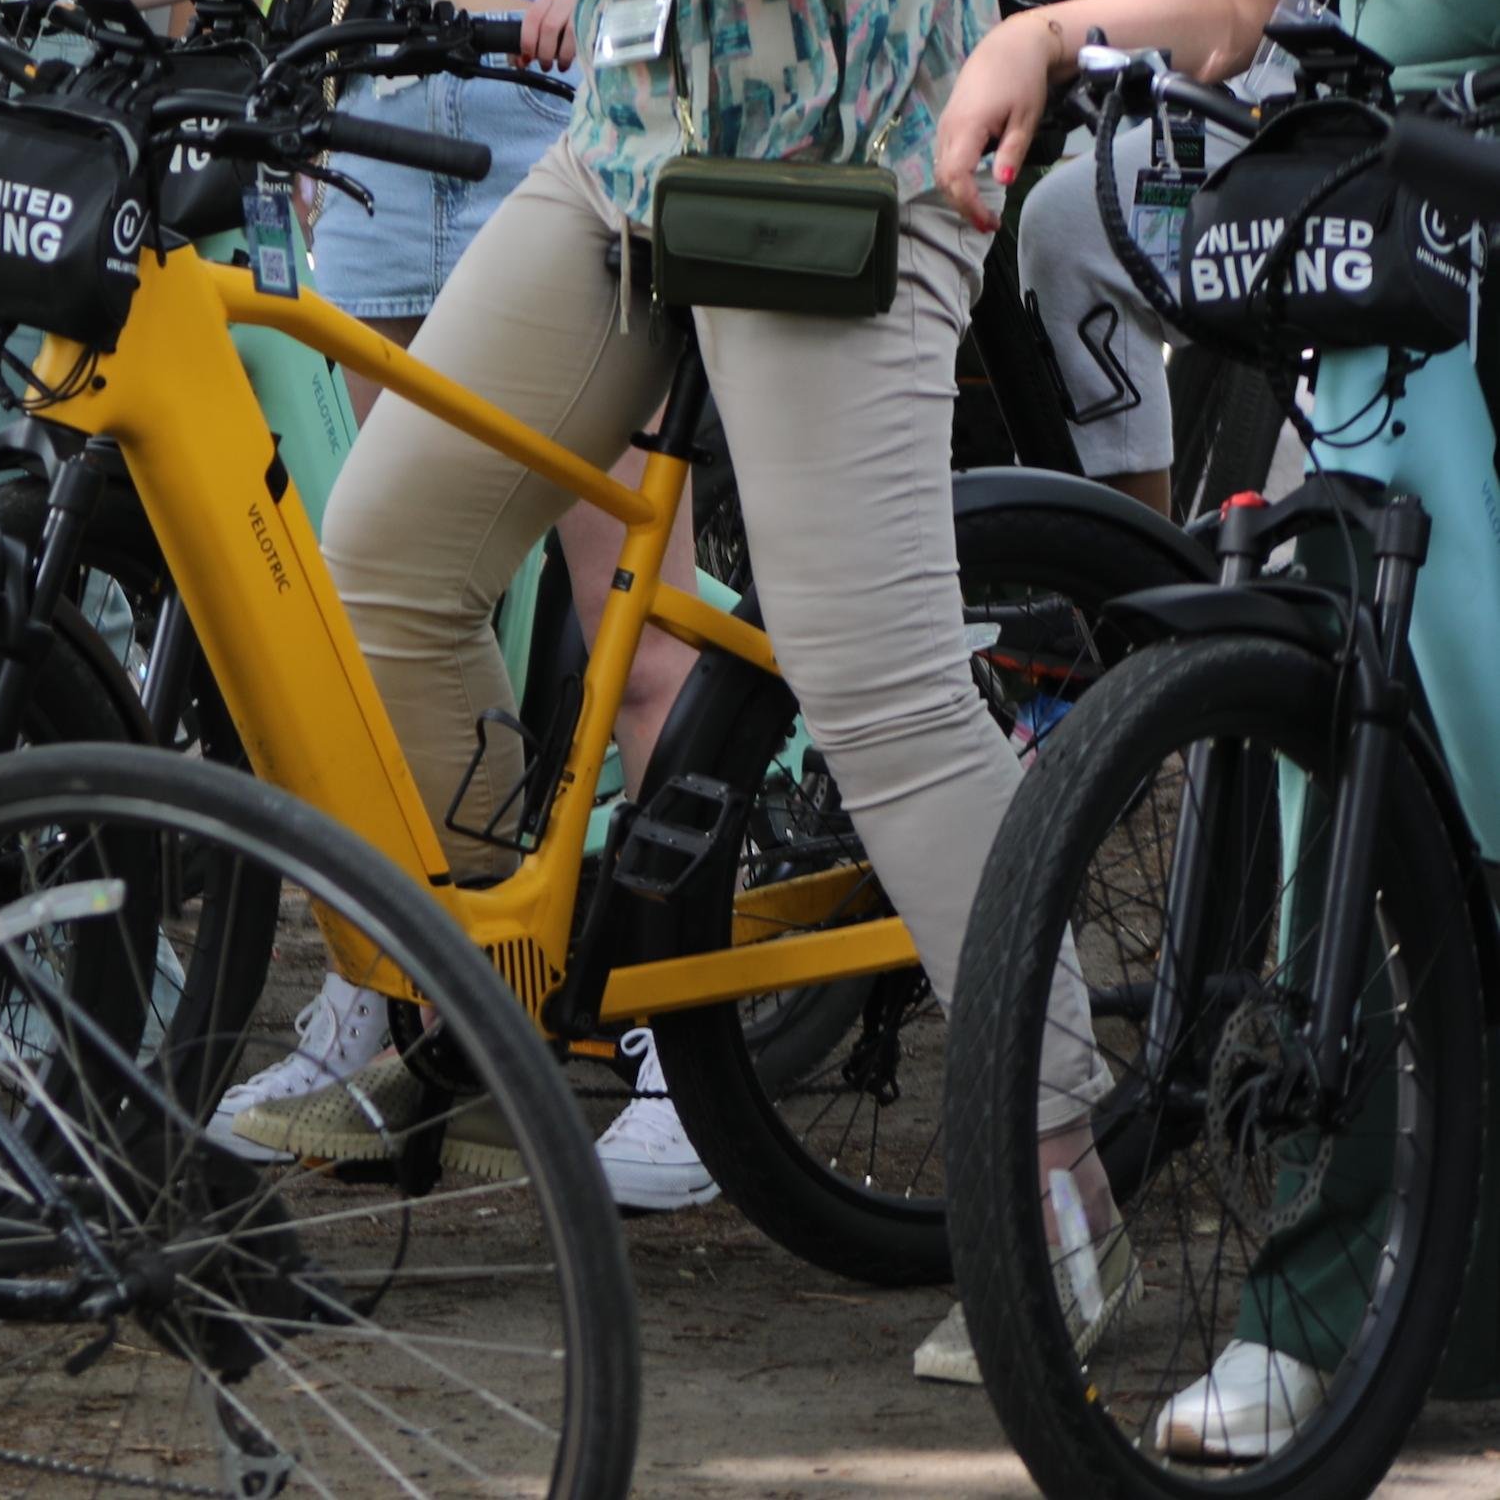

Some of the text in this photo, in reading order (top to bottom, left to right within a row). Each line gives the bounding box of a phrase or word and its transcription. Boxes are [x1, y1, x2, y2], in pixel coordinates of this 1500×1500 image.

[1194, 216, 1374, 256] NLIMTED
[1191, 247, 1374, 302] BIKNG
[312, 373, 341, 455] VELOTRIC
[1482, 478, 1500, 543] VELO
[248, 503, 291, 595] VELOTRIC
